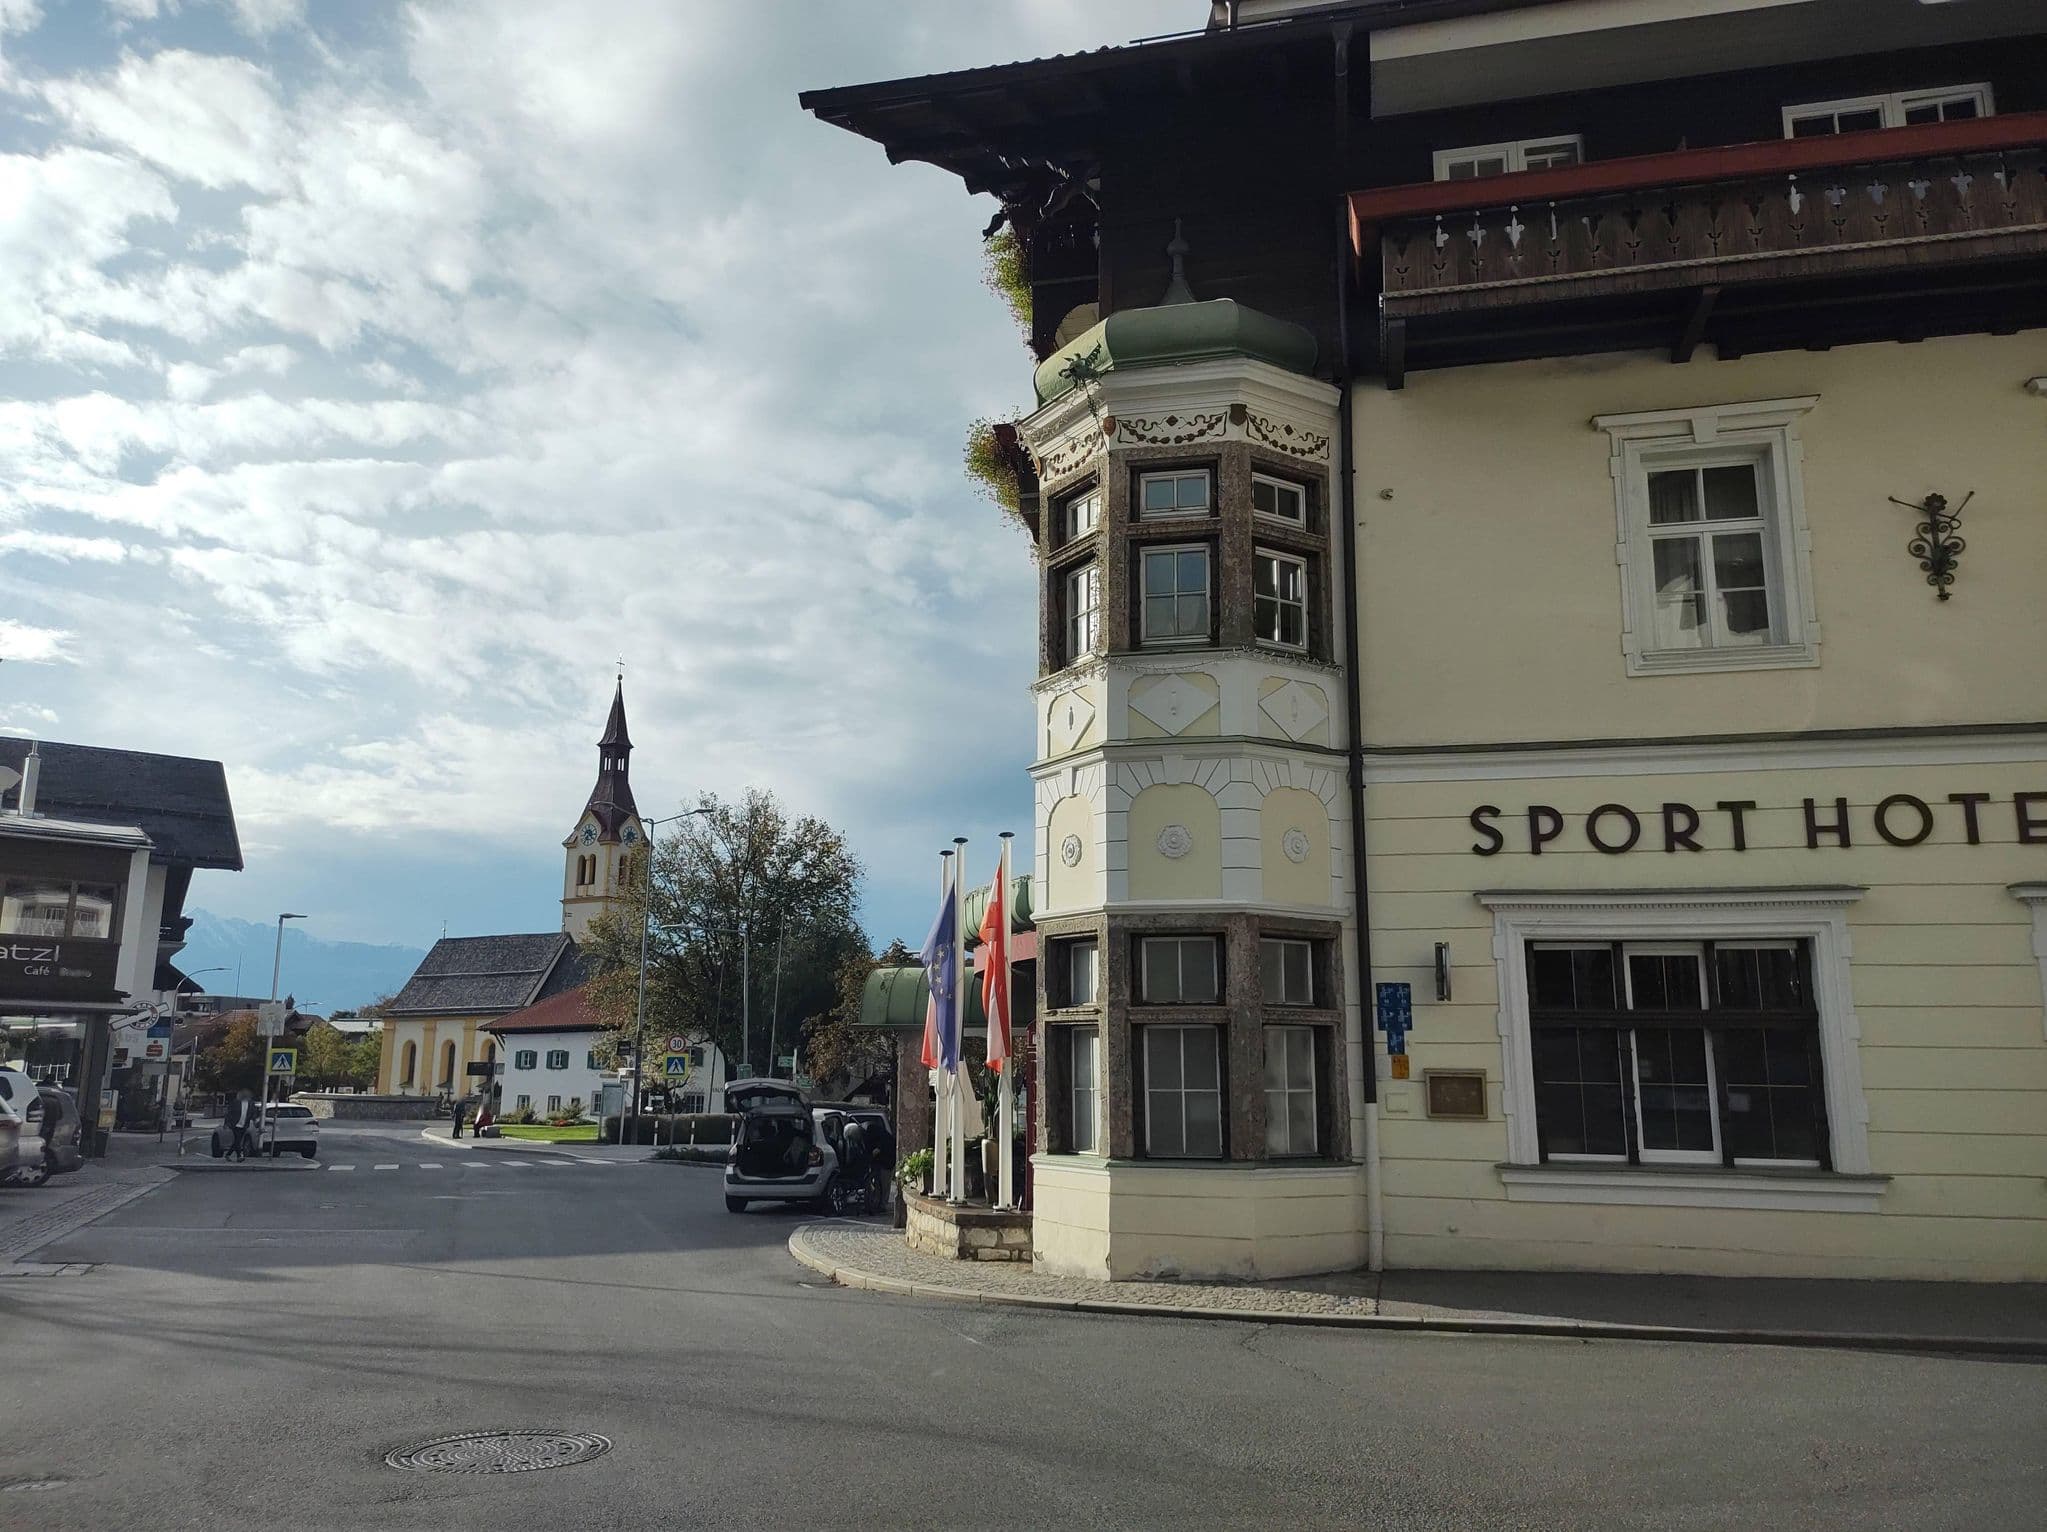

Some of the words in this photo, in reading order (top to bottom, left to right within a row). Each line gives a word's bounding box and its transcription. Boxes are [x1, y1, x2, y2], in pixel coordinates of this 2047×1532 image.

[1470, 800, 1756, 857] SPORT
[24, 965, 50, 976] Café
[672, 1039, 682, 1049] 30
